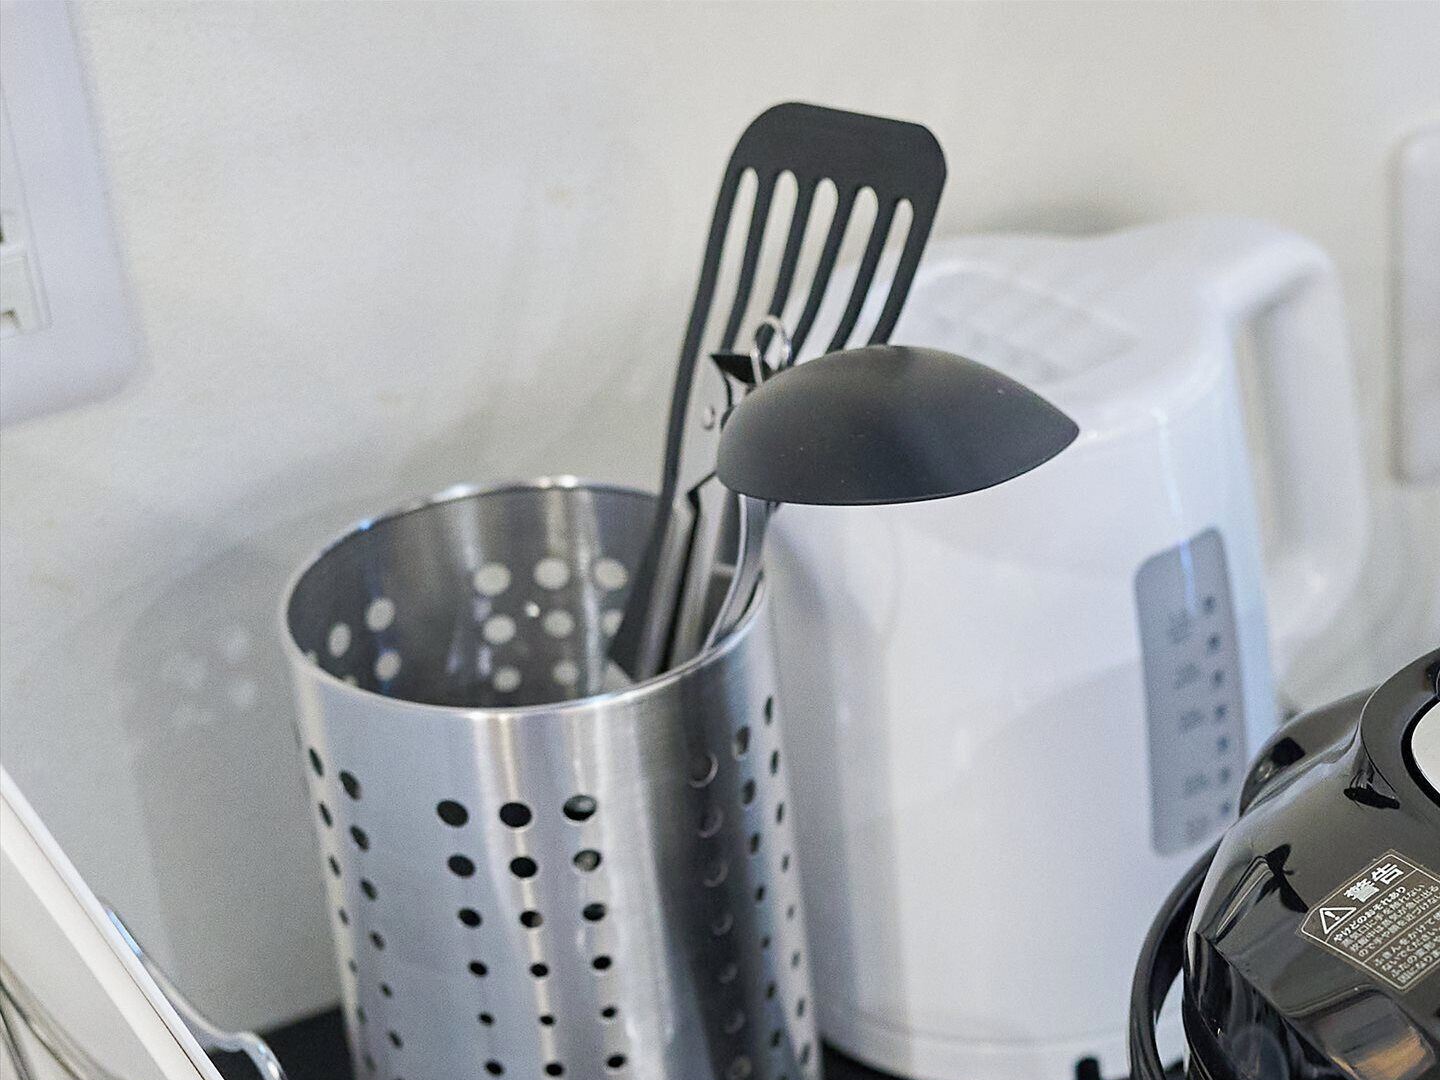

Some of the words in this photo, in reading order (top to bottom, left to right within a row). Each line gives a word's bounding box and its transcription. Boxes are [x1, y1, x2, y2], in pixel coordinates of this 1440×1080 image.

[1344, 863, 1404, 902] 警告
[1334, 887, 1406, 943] やけどのおそれあり
[1341, 885, 1425, 948] 蒸気口に手を触れない
